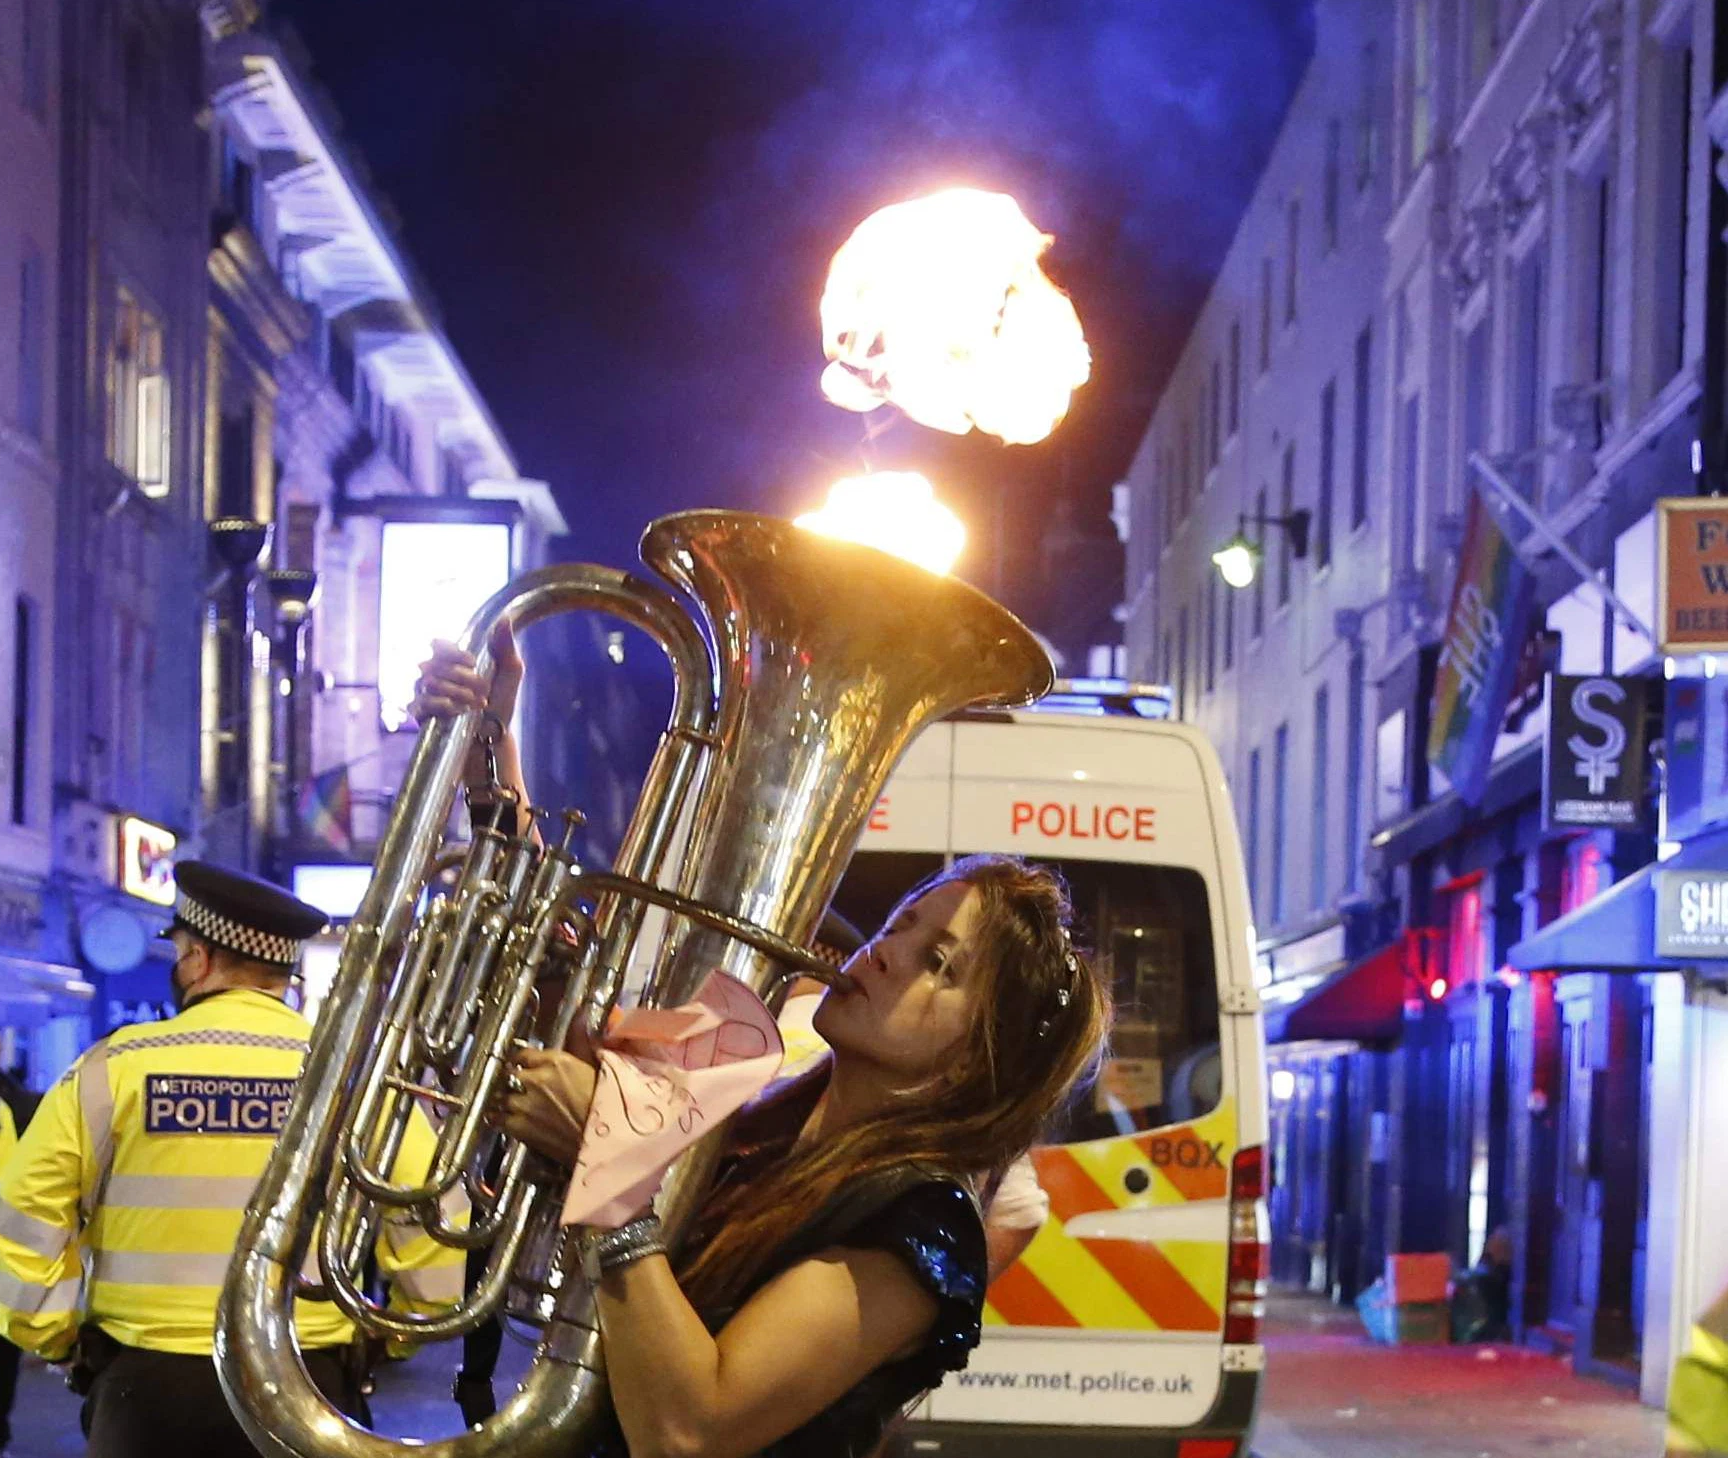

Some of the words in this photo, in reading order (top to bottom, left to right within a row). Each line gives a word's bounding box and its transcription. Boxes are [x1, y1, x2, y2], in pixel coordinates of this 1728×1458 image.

[1010, 801, 1157, 842] POLICE
[151, 1078, 296, 1098] METROPOLITAN
[150, 1097, 290, 1129] POLICE
[956, 1370, 1195, 1396] www.met.police.uk
